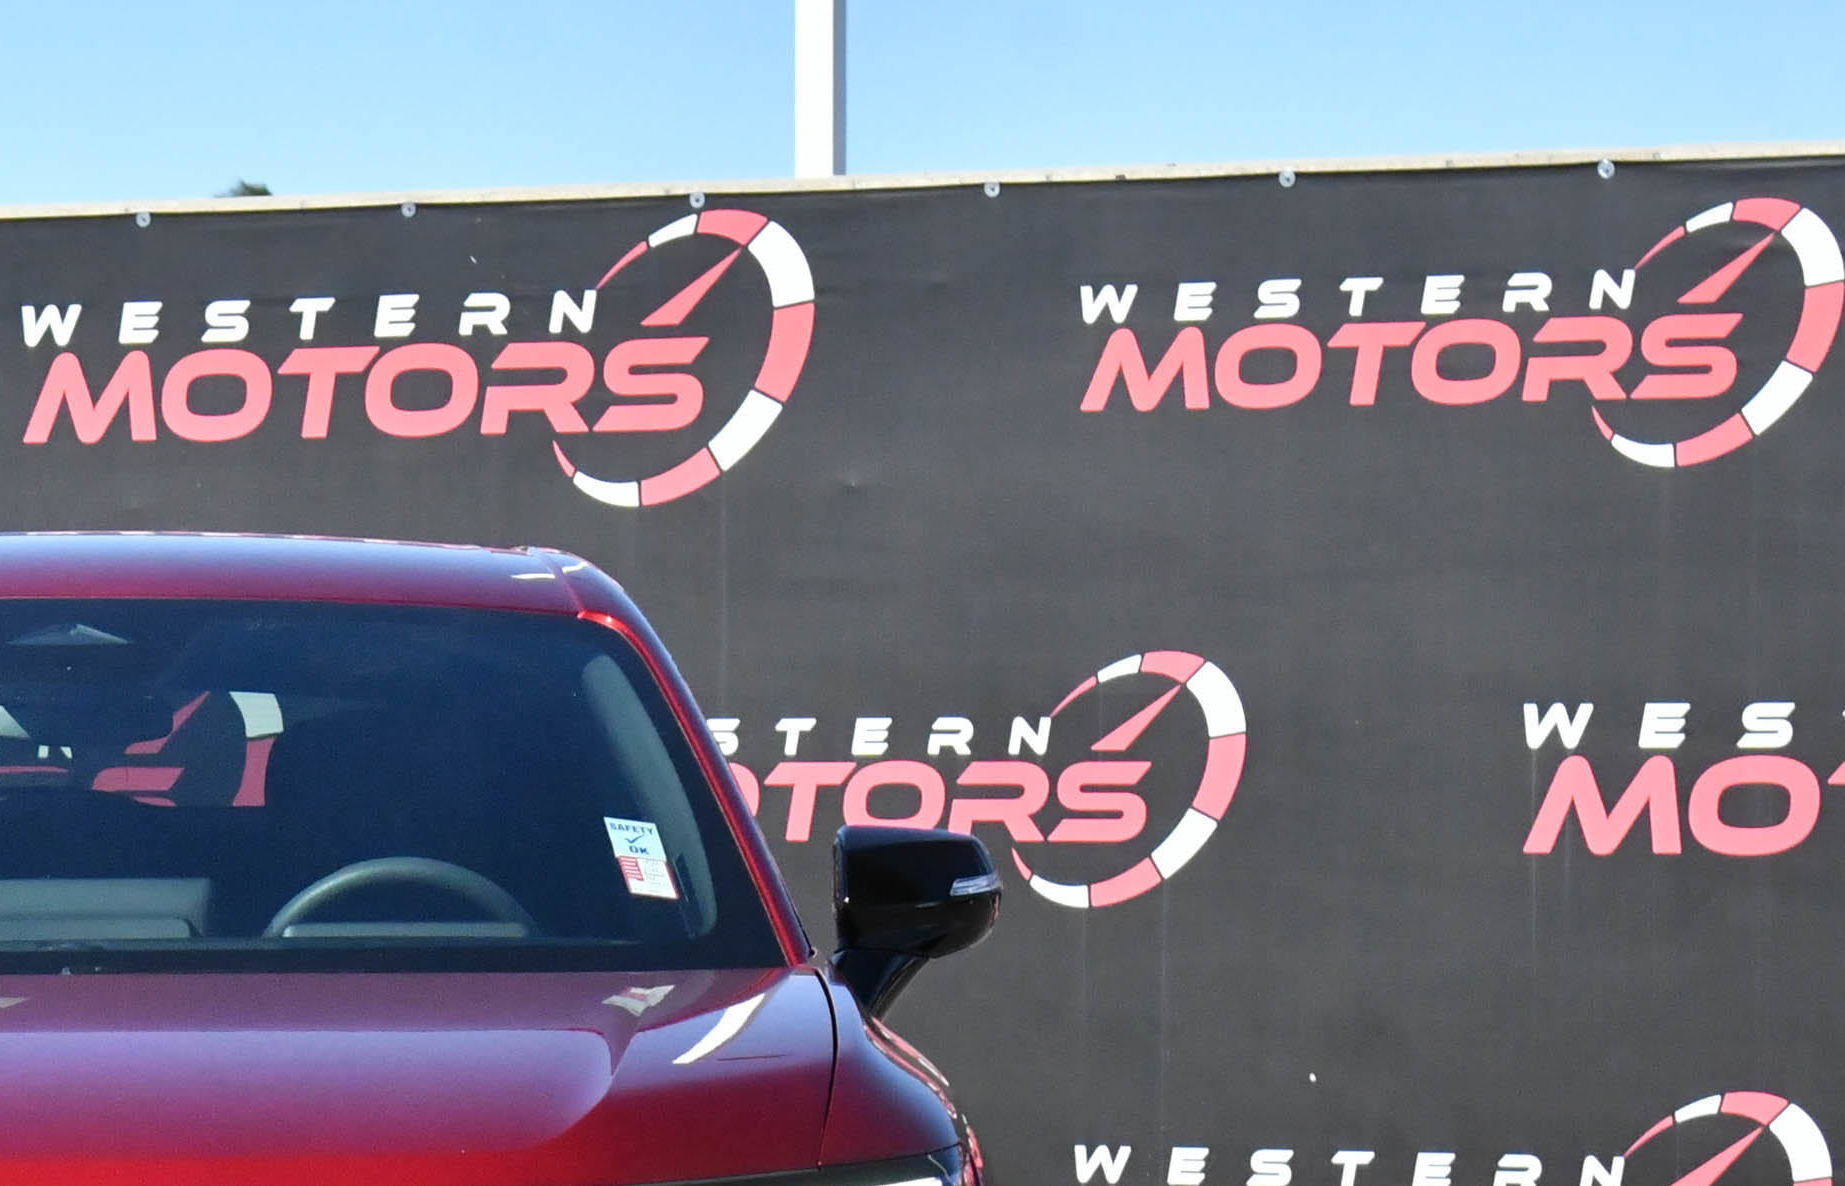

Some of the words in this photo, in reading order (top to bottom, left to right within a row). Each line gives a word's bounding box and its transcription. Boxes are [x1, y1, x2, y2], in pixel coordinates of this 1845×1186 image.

[21, 289, 598, 348] WESTERN
[1079, 268, 1636, 325] WESTERN
[23, 336, 710, 445] MOTORS
[1080, 312, 1743, 412] MOTORS
[610, 823, 653, 835] SAFETY
[1522, 755, 1845, 858] MO
[629, 845, 649, 855] OK
